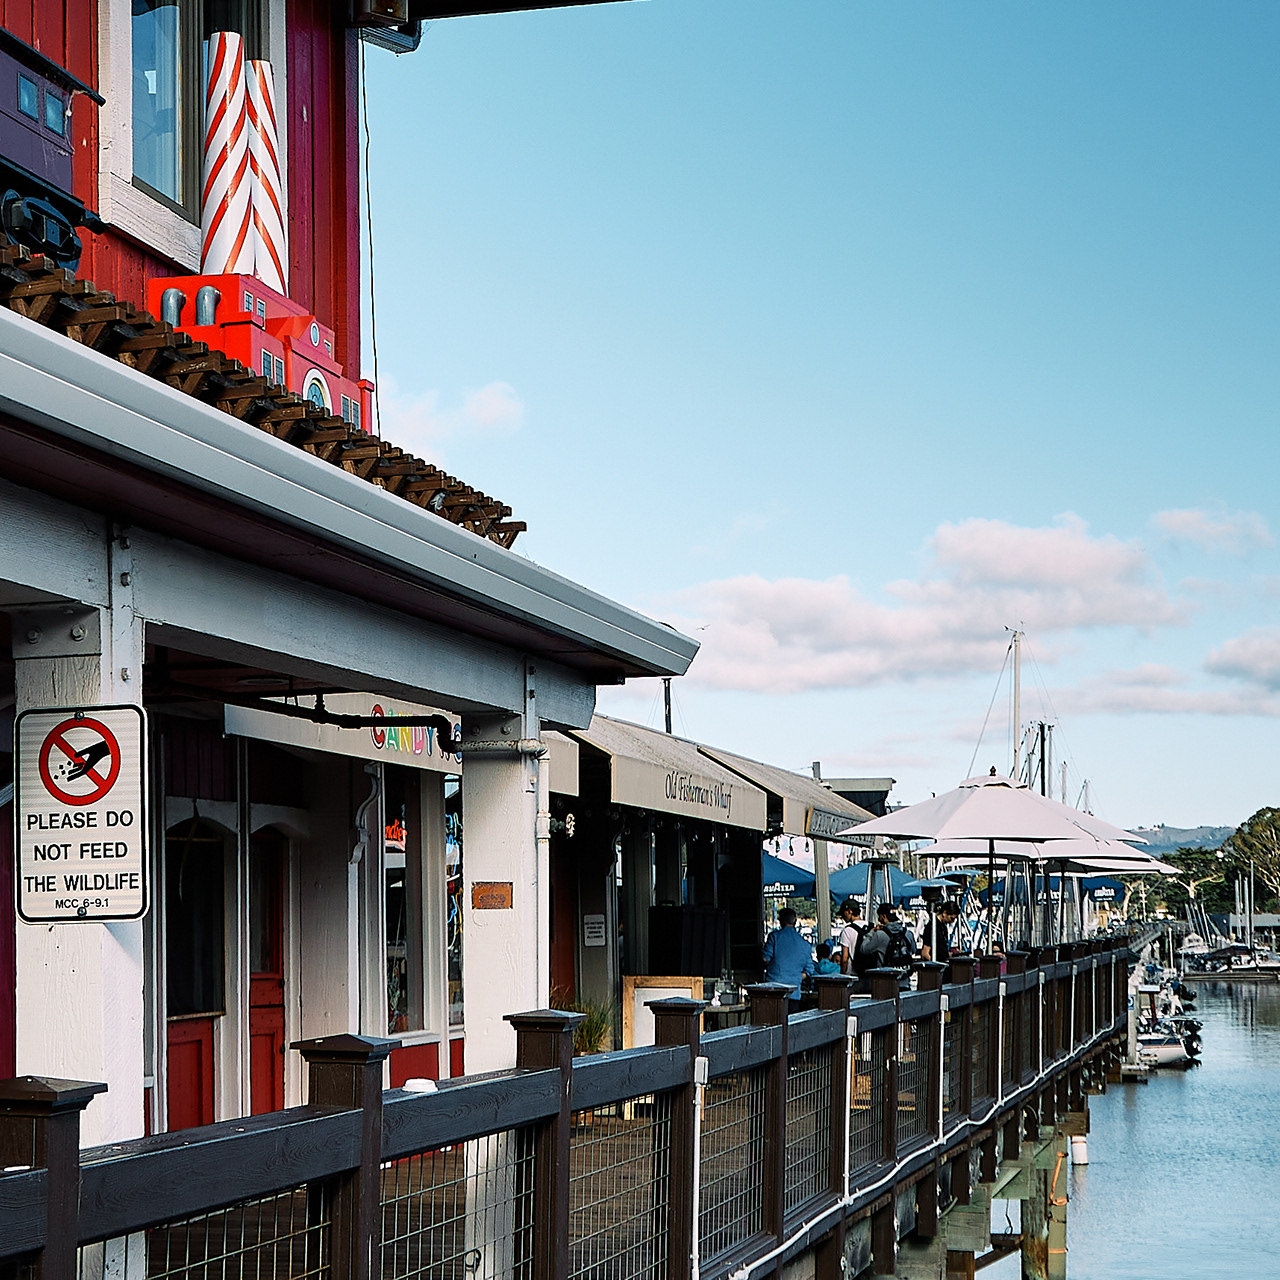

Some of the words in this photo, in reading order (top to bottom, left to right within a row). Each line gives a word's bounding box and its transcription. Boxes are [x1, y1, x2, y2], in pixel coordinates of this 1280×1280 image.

[370, 704, 463, 764] CANDY
[665, 771, 679, 799] Old
[679, 774, 713, 807] Fisherman's
[713, 782, 733, 819] Wharf
[27, 811, 98, 830] PLEASE
[106, 810, 134, 827] DO
[34, 843, 72, 861] NOT
[80, 842, 128, 859] FEED
[24, 875, 57, 892] THE
[64, 873, 140, 891] WILDLIFE
[763, 882, 795, 892] AVAZZA
[55, 899, 79, 908] MCC
[82, 898, 109, 907] 6-9.1
